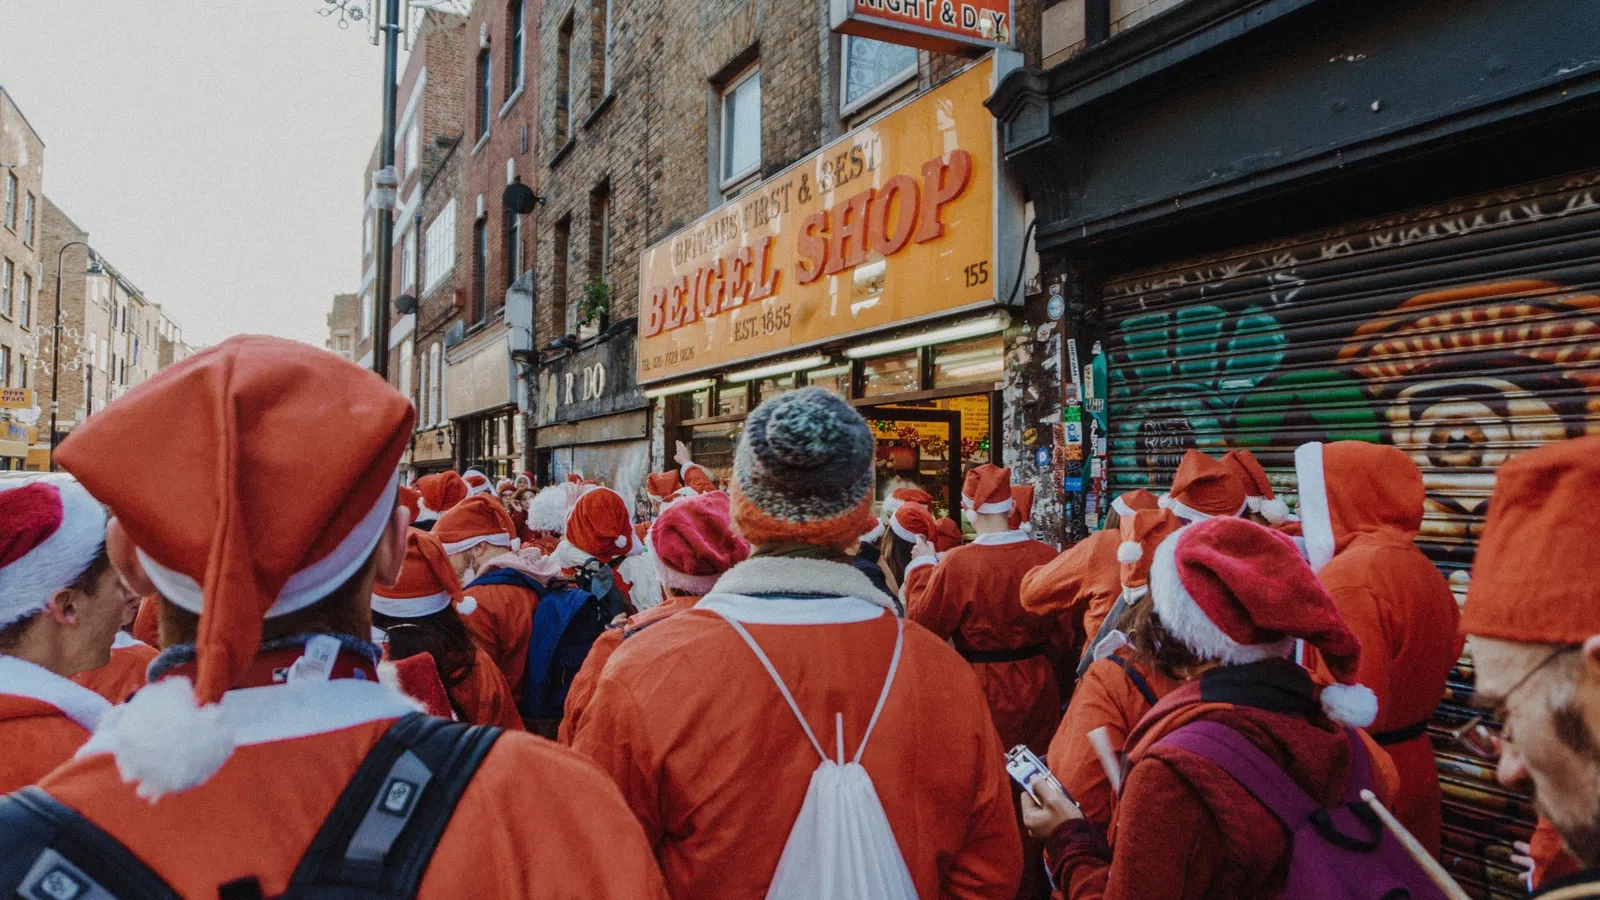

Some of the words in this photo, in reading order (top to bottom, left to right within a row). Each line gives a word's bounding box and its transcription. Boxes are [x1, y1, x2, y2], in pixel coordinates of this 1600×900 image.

[859, 0, 936, 20] GHT
[941, 3, 955, 24] &
[743, 180, 792, 232] FIRST
[798, 173, 812, 205] &
[819, 134, 880, 193] BEST
[645, 235, 781, 338] BEIGEL
[795, 149, 972, 286] SHOP
[964, 261, 988, 288] 155
[734, 317, 759, 342] EST.
[762, 304, 791, 335] 1855
[564, 372, 574, 405] R
[583, 362, 606, 400] DO
